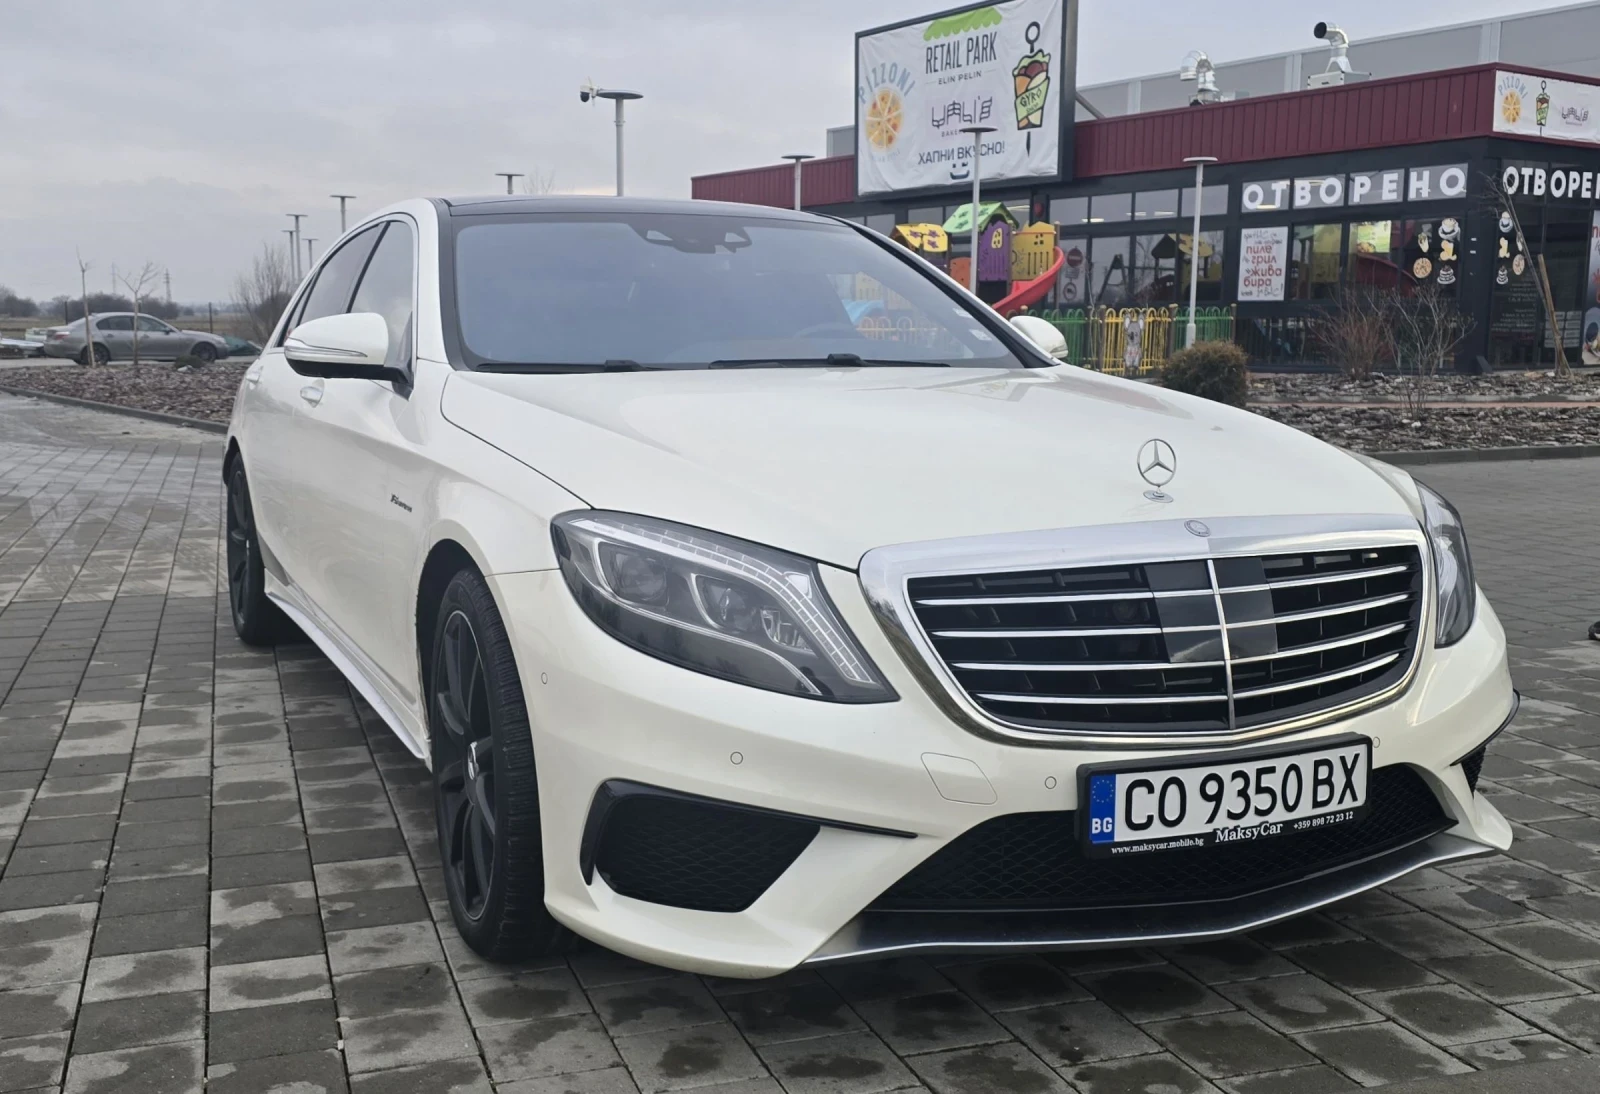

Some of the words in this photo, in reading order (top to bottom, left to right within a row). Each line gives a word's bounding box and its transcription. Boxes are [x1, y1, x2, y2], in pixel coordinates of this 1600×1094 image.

[925, 42, 962, 75] RETAIL
[966, 32, 998, 66] PARK
[858, 62, 915, 104] PIZZONI
[937, 75, 956, 85] ELIN
[957, 71, 982, 81] PELIN
[1497, 75, 1528, 99] PIZZONI
[1019, 87, 1042, 108] GYRO
[917, 147, 955, 165] ХАПНИ
[1243, 167, 1468, 210] ОТВОРЕНО
[1246, 245, 1272, 255] пиле
[1251, 256, 1277, 266] грил
[1250, 264, 1282, 277] жива
[1243, 276, 1272, 288] бира
[1124, 776, 1187, 832] CO
[1199, 763, 1304, 825] 9350
[1311, 753, 1361, 809] BX
[1091, 817, 1113, 834] BG
[1293, 820, 1311, 830] +359
[1312, 816, 1325, 827] 898
[1326, 815, 1335, 824] 72
[1335, 813, 1344, 823] 23
[1345, 811, 1354, 820] 12
[1215, 821, 1283, 843] MaksyCar
[1111, 837, 1204, 855] www.maksycar.mobile.bg
